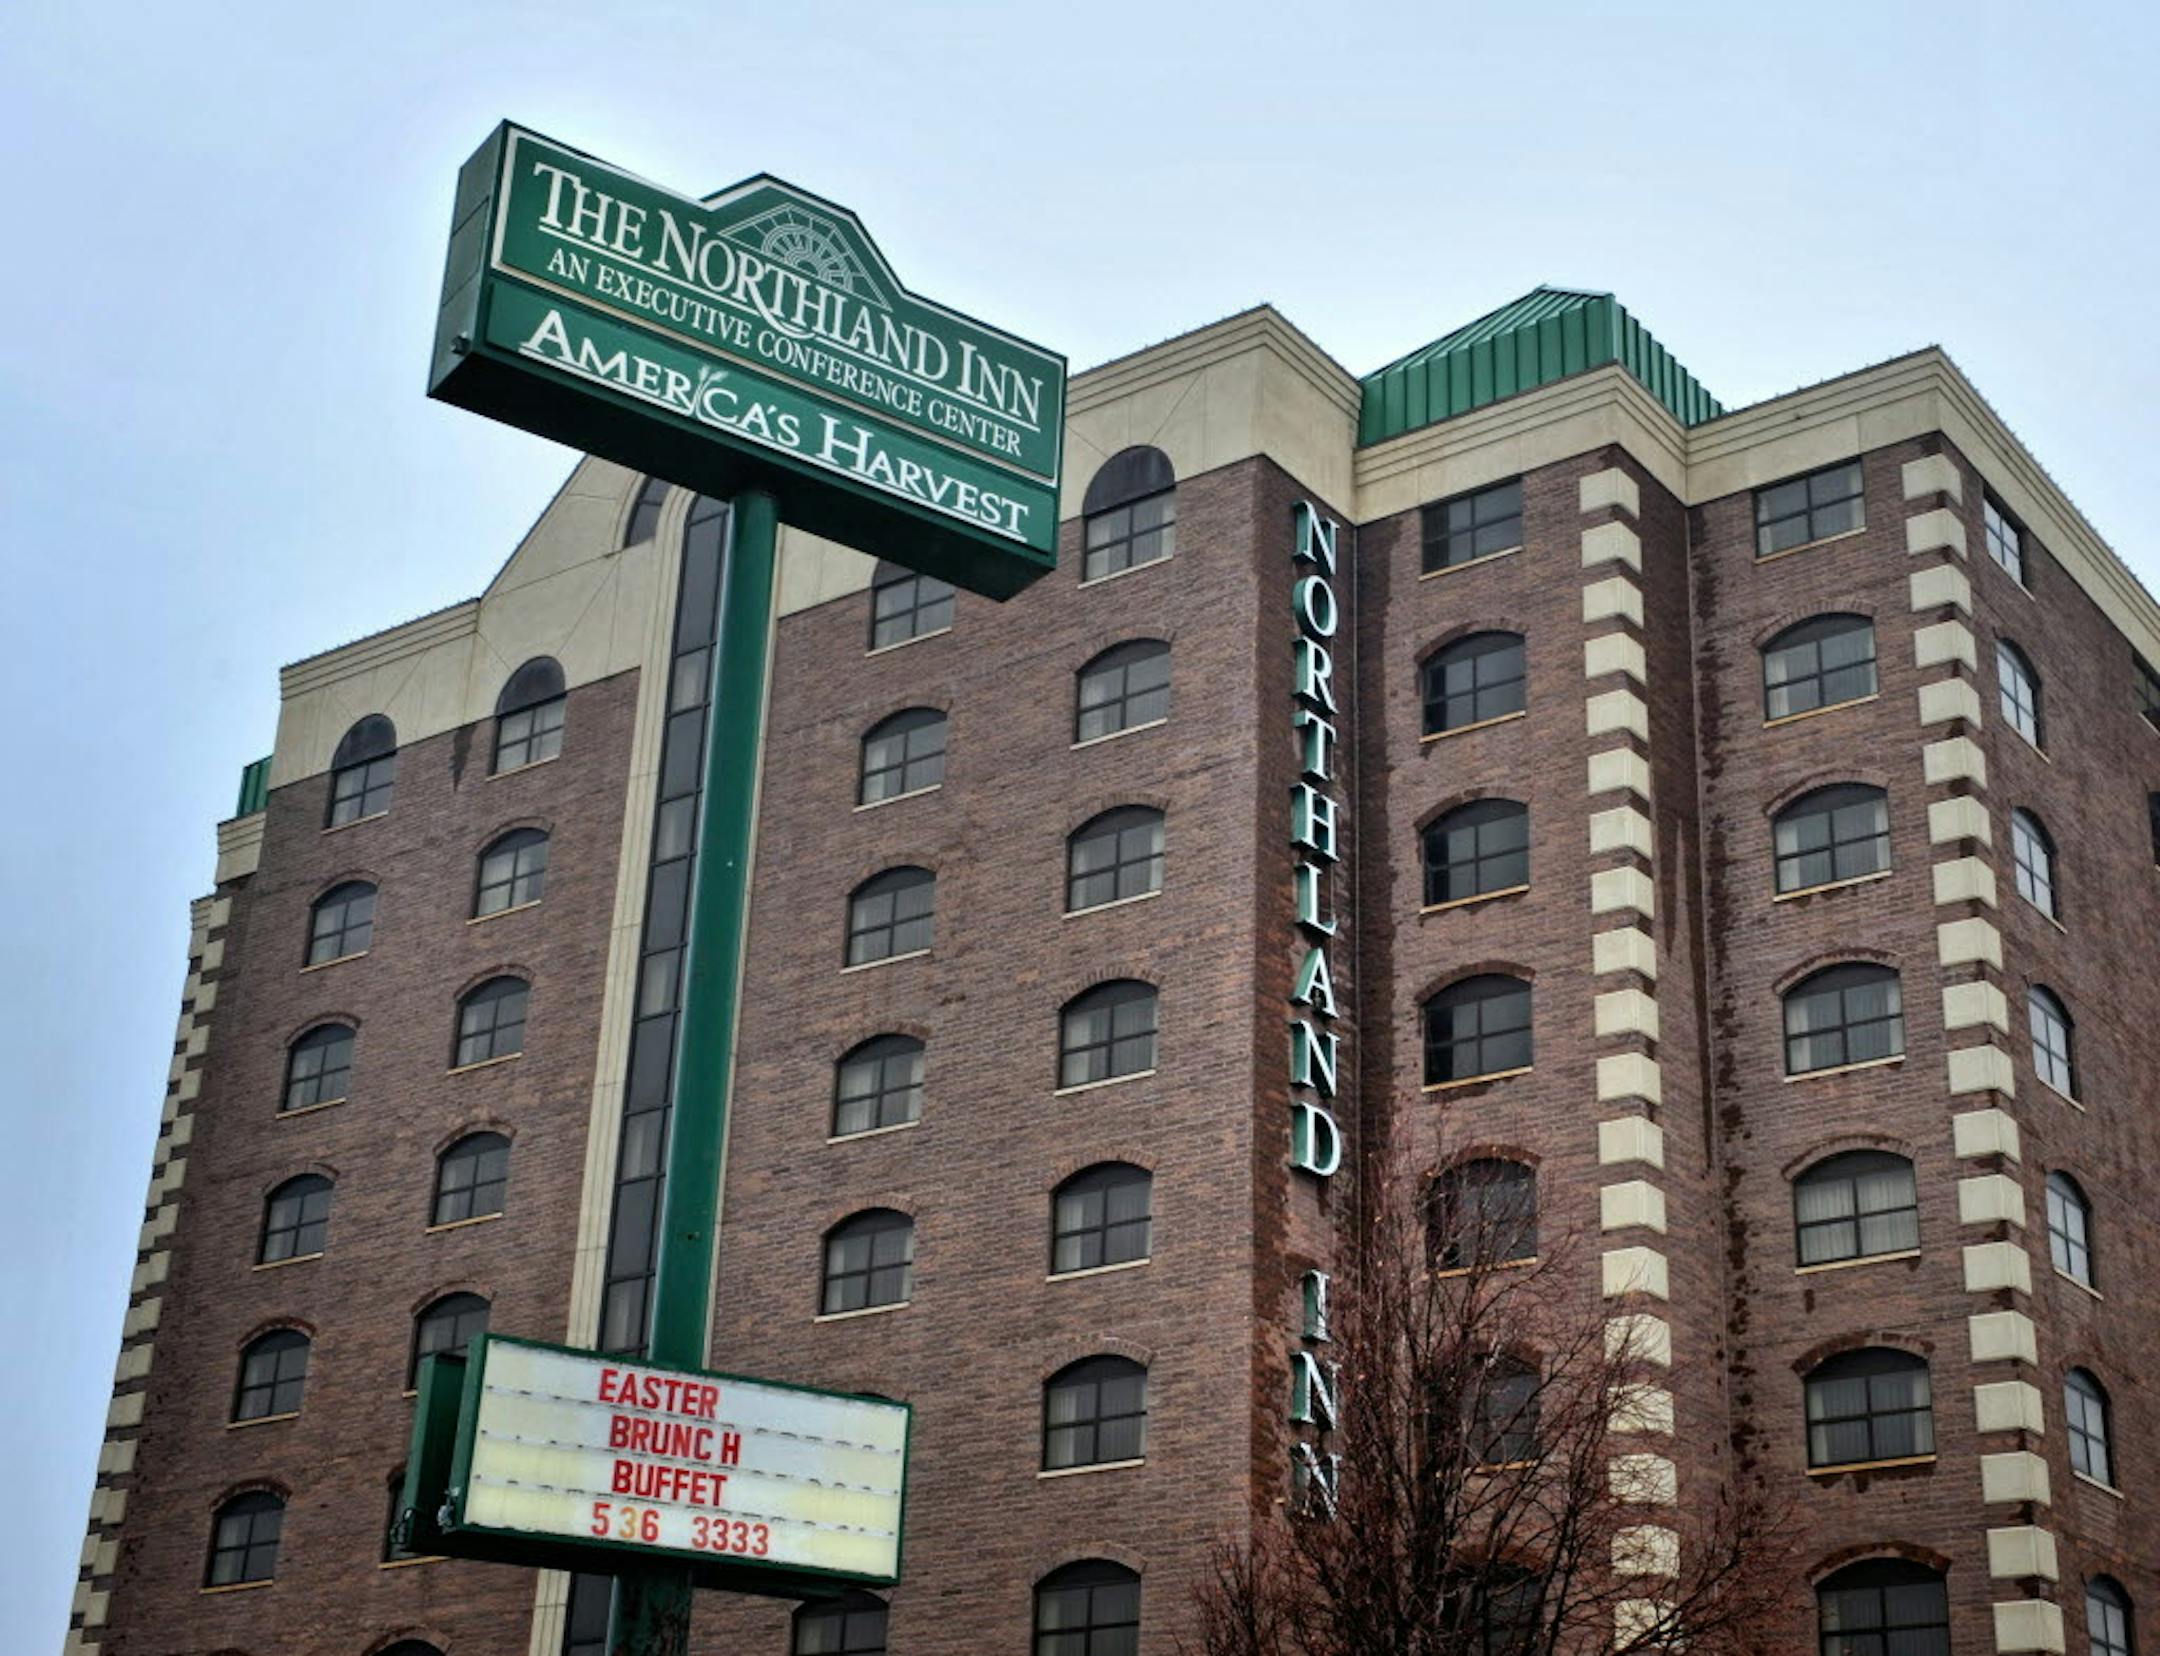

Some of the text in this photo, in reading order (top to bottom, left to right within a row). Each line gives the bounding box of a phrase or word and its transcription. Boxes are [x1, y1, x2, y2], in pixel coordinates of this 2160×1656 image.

[534, 161, 1042, 425] THE NORTHLAND INN
[548, 248, 1022, 457] AN EXECUTIVE CONFERENCE CENTER
[817, 413, 1028, 536] HARVEST
[1297, 501, 1341, 1178] NORTHLAND
[600, 1368, 720, 1419] EASTER
[609, 1415, 742, 1467] BRUNCH
[1298, 1269, 1342, 1521] INN
[590, 1501, 770, 1557] 536 3333
[611, 1459, 727, 1507] BUFFET
